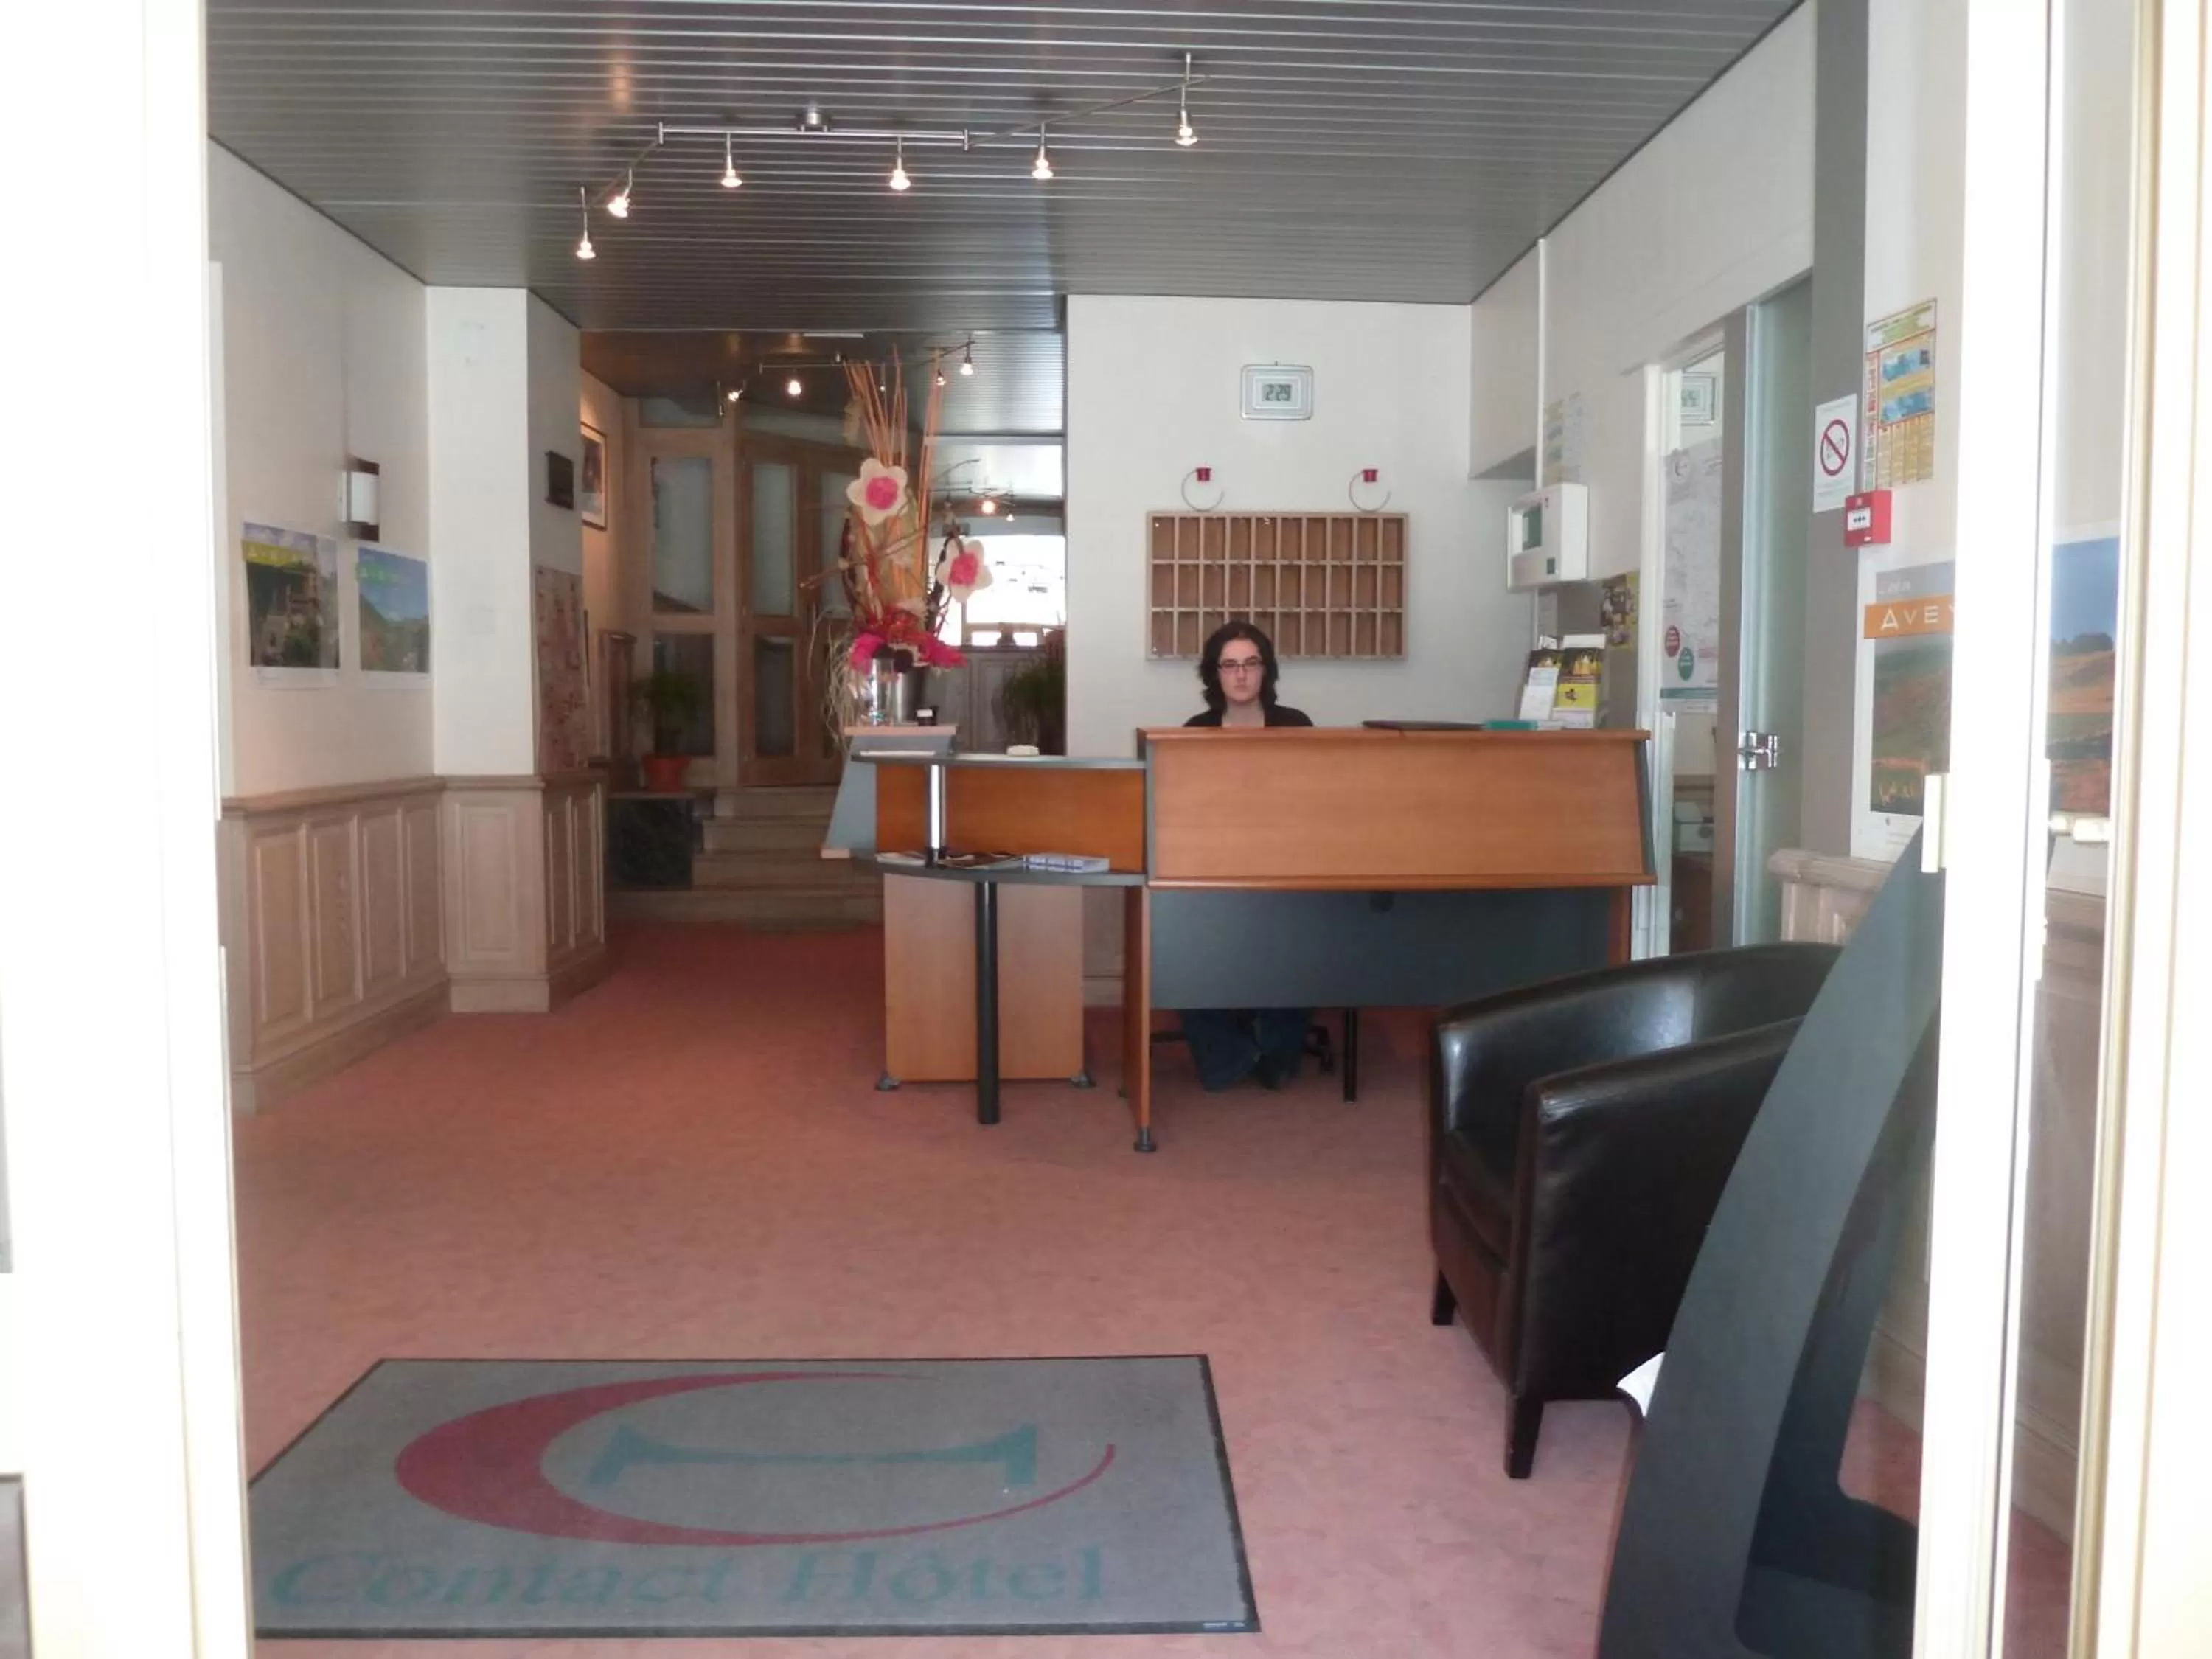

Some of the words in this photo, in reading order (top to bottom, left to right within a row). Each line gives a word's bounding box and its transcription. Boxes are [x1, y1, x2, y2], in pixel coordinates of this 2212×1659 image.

[1879, 603, 1954, 632] AVE
[270, 1549, 727, 1605] Contact
[779, 1545, 1103, 1603] Hôtel
